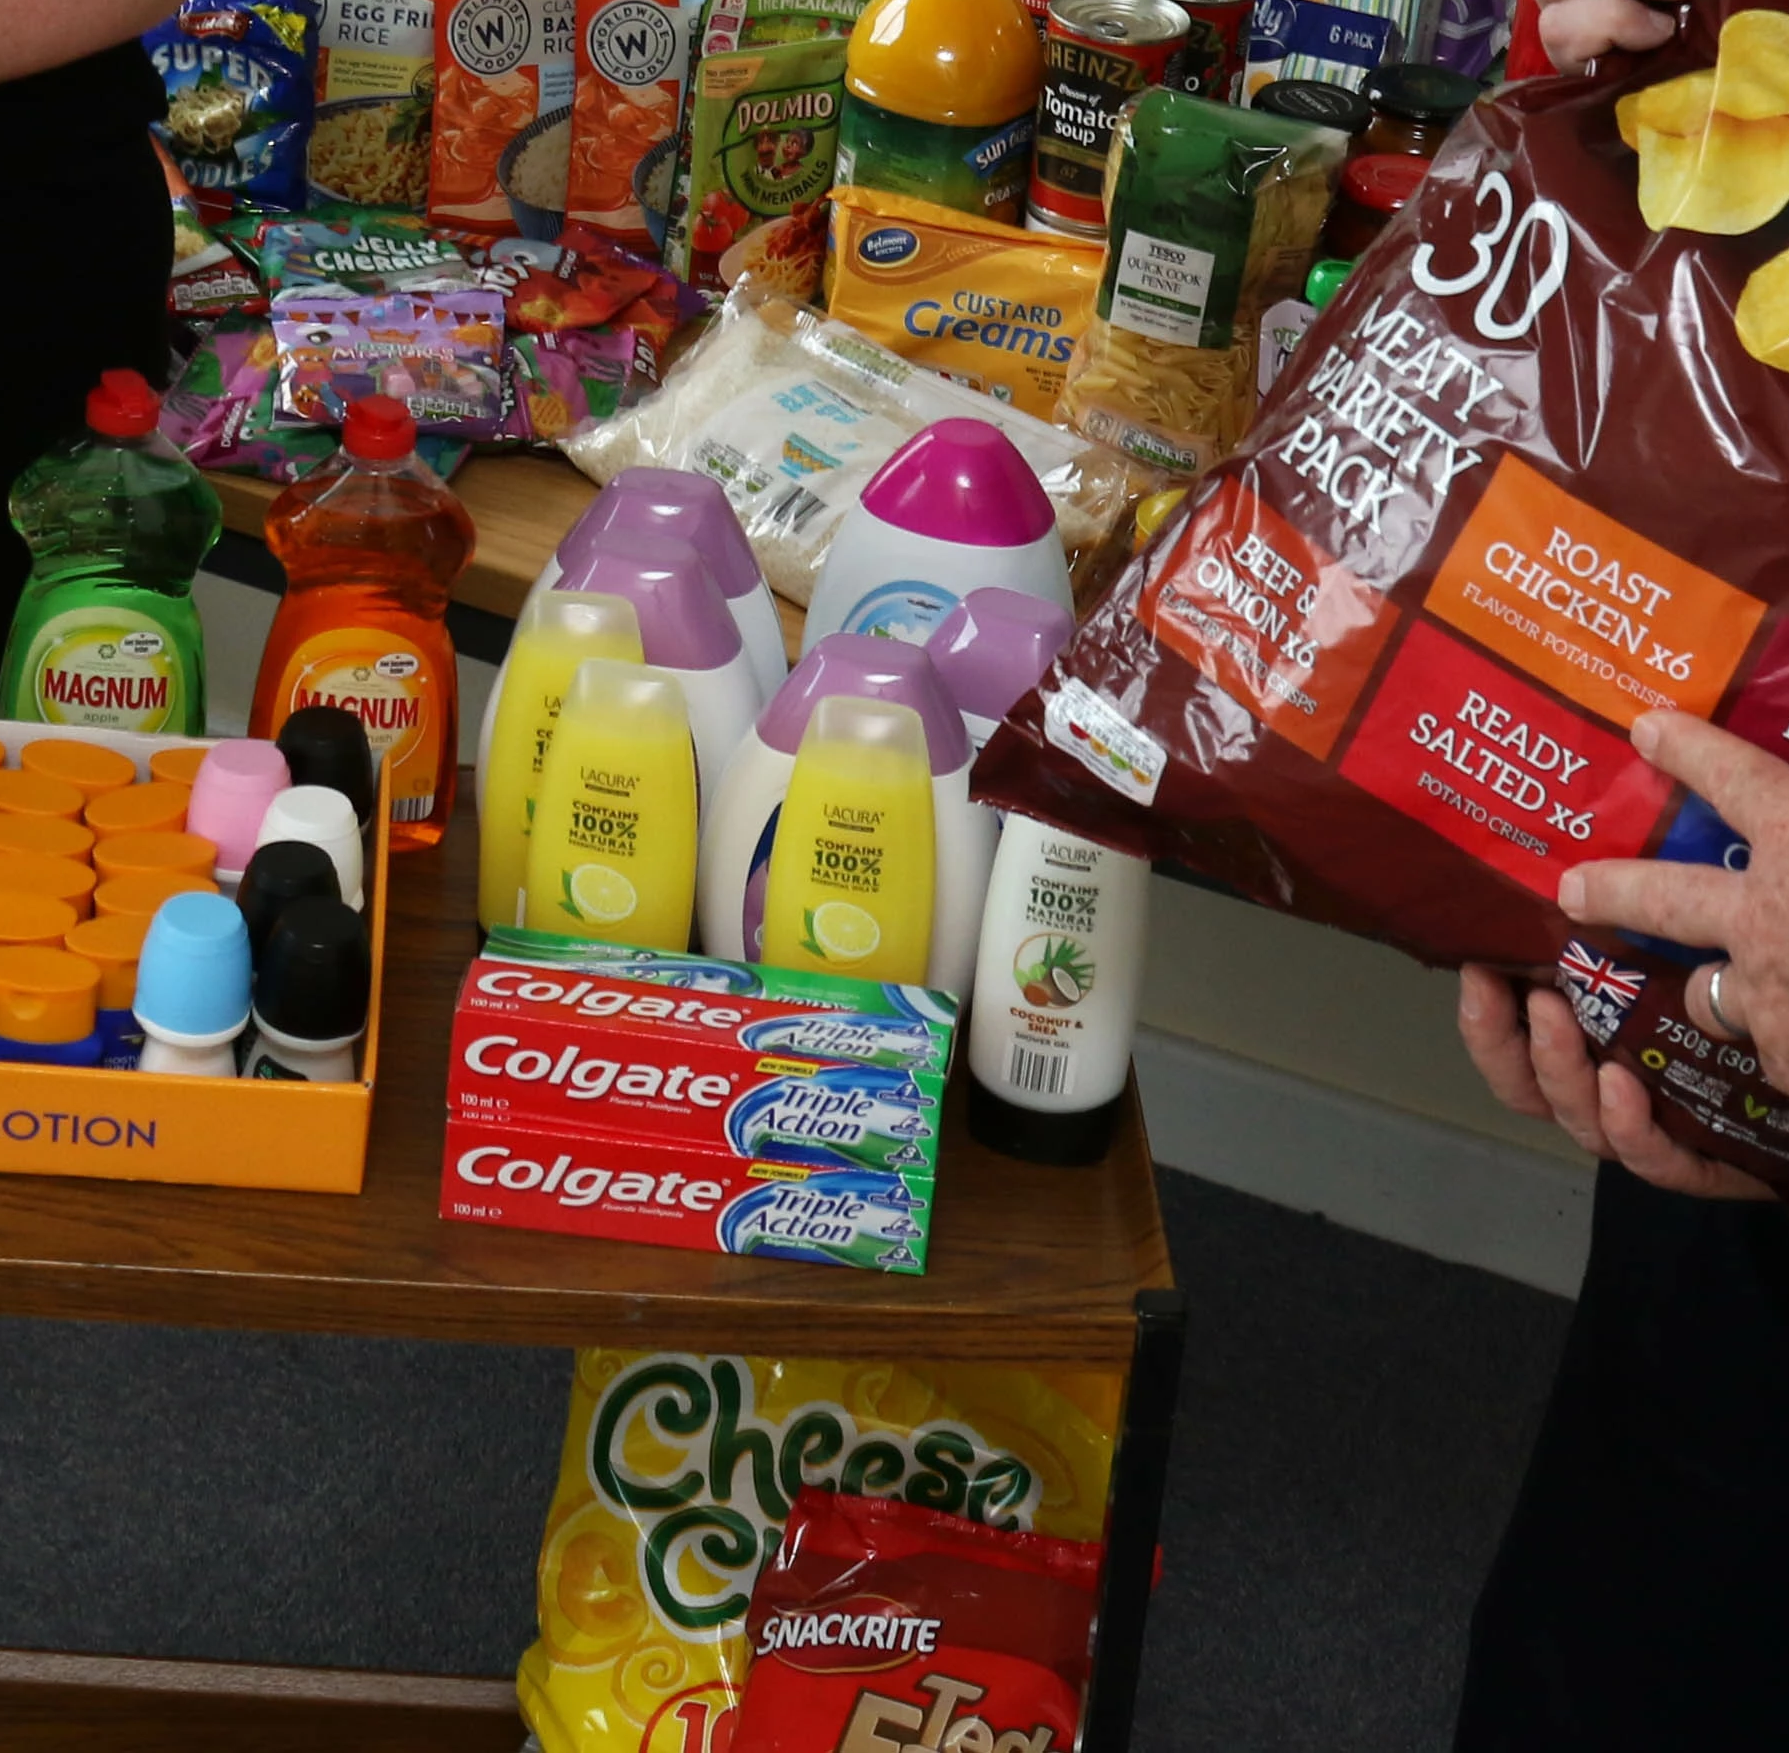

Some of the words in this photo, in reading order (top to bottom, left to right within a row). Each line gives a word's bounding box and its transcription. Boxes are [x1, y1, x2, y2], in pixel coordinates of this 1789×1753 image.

[340, 2, 385, 23] EGG
[394, 9, 435, 29] FRI
[596, 4, 670, 53] WORLDWIDE
[338, 23, 391, 46] RICE
[475, 15, 505, 50] W
[614, 30, 648, 62] W
[1329, 25, 1340, 43] 6
[1343, 30, 1375, 49] PACK
[473, 42, 523, 69] FOODS
[613, 56, 666, 80] FOODS
[1050, 42, 1126, 87] HEINZ
[737, 92, 834, 135] DOLMIO
[1055, 118, 1096, 146] soup
[180, 147, 274, 188] ODLES
[761, 159, 830, 208] MEATBALLS
[867, 235, 908, 251] Belmont
[1150, 244, 1187, 262] TESCO
[1411, 170, 1572, 342] 30
[1127, 257, 1165, 276] QUICK
[1166, 267, 1202, 287] COOK
[1141, 274, 1181, 295] PENNE
[953, 291, 1062, 327] CUSTARD
[904, 299, 1075, 363] Creams
[1352, 292, 1504, 423] MEATY
[1306, 347, 1485, 496] VARIETY
[1279, 416, 1405, 538] PACK
[1232, 533, 1304, 598] BEEF
[1295, 584, 1320, 619] &
[1543, 525, 1671, 618] ROAST
[1196, 555, 1289, 643] ONION
[1279, 630, 1322, 668] x6
[1483, 540, 1648, 654] CHICKEN
[1645, 641, 1691, 683] x6
[1461, 581, 1540, 643] FLAVOUR
[1540, 625, 1616, 684] POTATO
[1614, 670, 1678, 712] CRISPS
[43, 667, 168, 710] MAGNUM
[1266, 671, 1318, 716] CRISPS
[83, 712, 120, 724] apple
[1456, 689, 1589, 786] READY
[579, 765, 637, 790] LACURA
[1409, 713, 1548, 814] SALTED
[1546, 801, 1593, 843] x6
[571, 811, 638, 840] 100%
[572, 799, 640, 823] CONTAINS
[822, 803, 882, 826] LACURA
[1416, 771, 1490, 829] POTATO
[1488, 814, 1549, 859] CRISPS
[568, 828, 637, 852] NATURAL
[815, 837, 885, 858] CONTAINS
[1040, 840, 1098, 865] LACURA
[811, 867, 881, 887] NATURAL
[814, 850, 882, 877] 100%
[1029, 887, 1097, 916] 100%
[1030, 874, 1100, 898] CONTAINS
[1025, 904, 1094, 928] NATURAL
[476, 970, 745, 1030] Colgate
[802, 1018, 885, 1043] Triple
[1009, 1006, 1072, 1029] COCONUT
[1027, 1023, 1059, 1037] SHEA
[774, 1032, 873, 1057] Action
[1655, 1015, 1713, 1059] 750g
[463, 1034, 733, 1109] Colgate
[460, 1093, 479, 1106] 100
[479, 1096, 494, 1108] ml
[780, 1083, 875, 1118] Triple
[750, 1107, 862, 1141] Action
[455, 1145, 724, 1212] Colgate
[453, 1202, 472, 1217] 100
[472, 1206, 487, 1218] ml
[772, 1187, 866, 1220] Triple
[743, 1210, 854, 1244] Action
[592, 1358, 1032, 1532] Cheese
[755, 1612, 942, 1656] SNACKRITE
